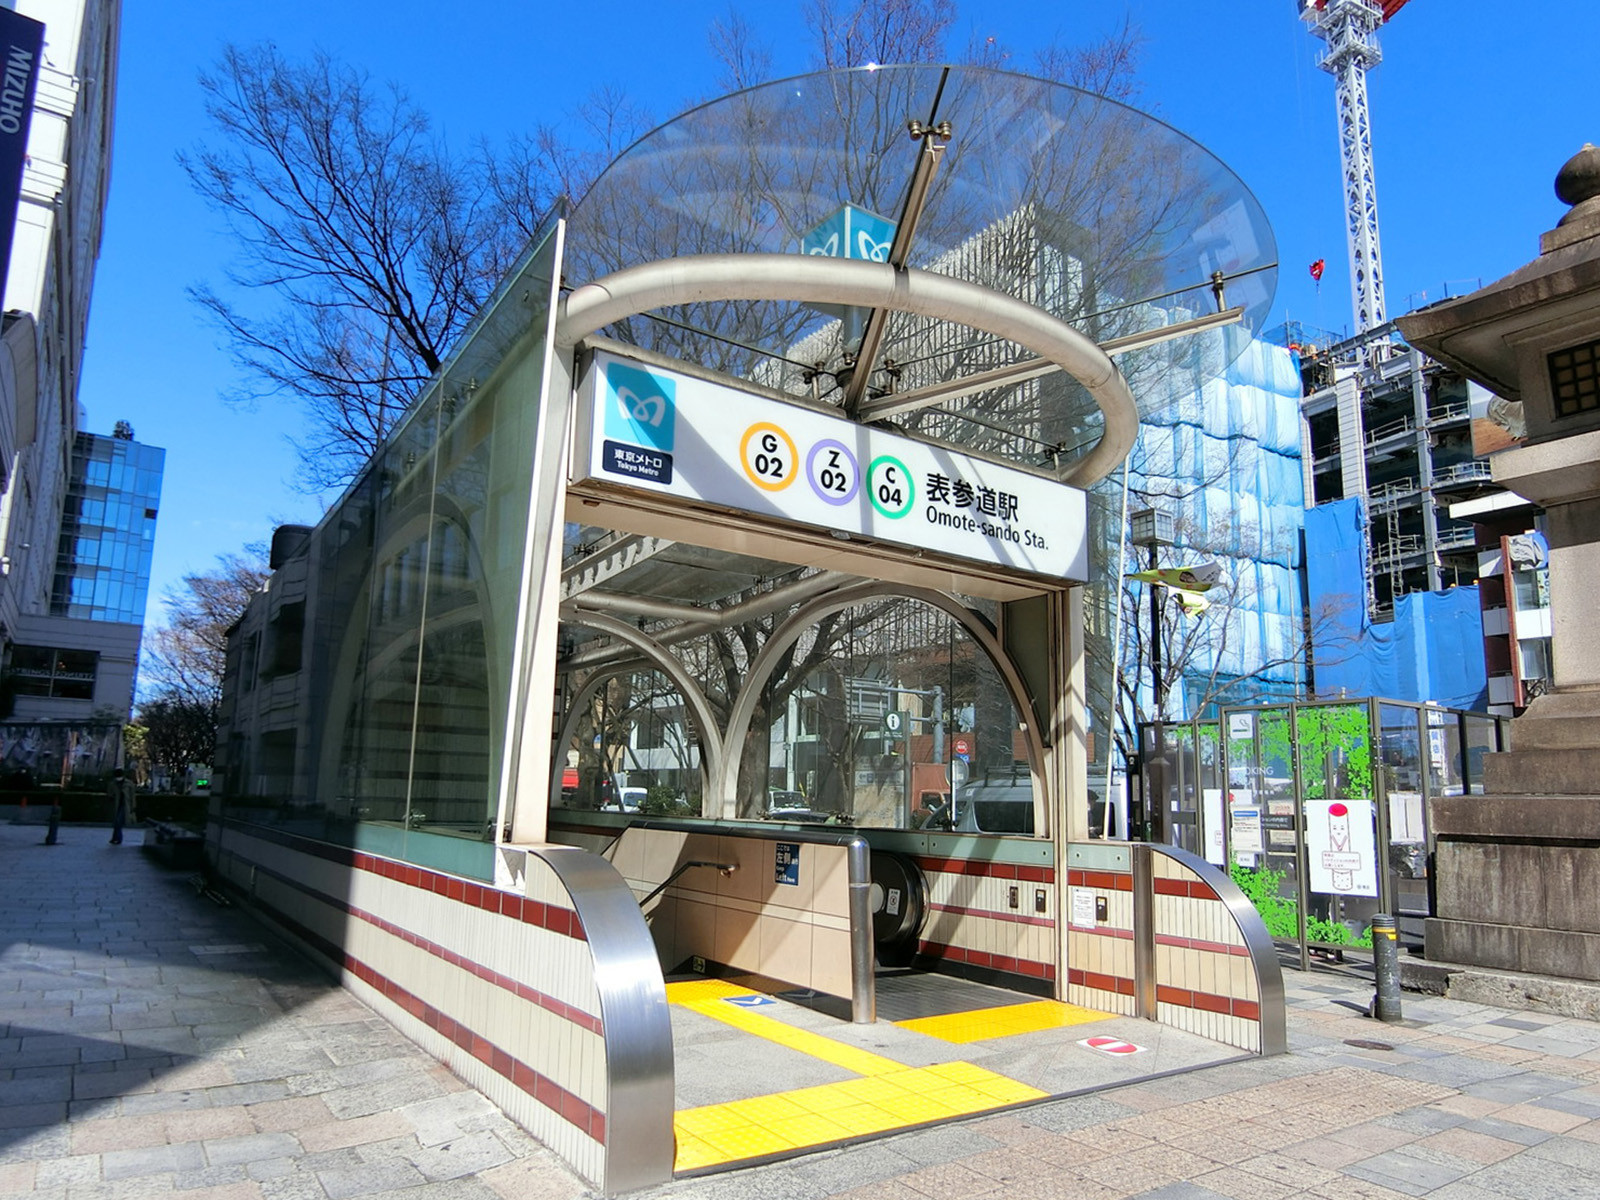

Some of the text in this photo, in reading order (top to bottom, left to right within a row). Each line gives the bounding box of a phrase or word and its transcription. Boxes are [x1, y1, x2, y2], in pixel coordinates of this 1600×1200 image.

[0, 45, 33, 134] MIZUHO
[762, 434, 778, 453] G
[614, 448, 662, 468] 東京メトロ
[616, 460, 660, 476] Tokyo Metro
[755, 454, 783, 478] 02
[828, 450, 840, 468] Z
[821, 469, 846, 492] 02
[885, 467, 896, 484] C
[878, 484, 902, 506] 04
[926, 473, 1019, 522] 表参道駅
[926, 505, 1049, 550] Omote-sando Sta.
